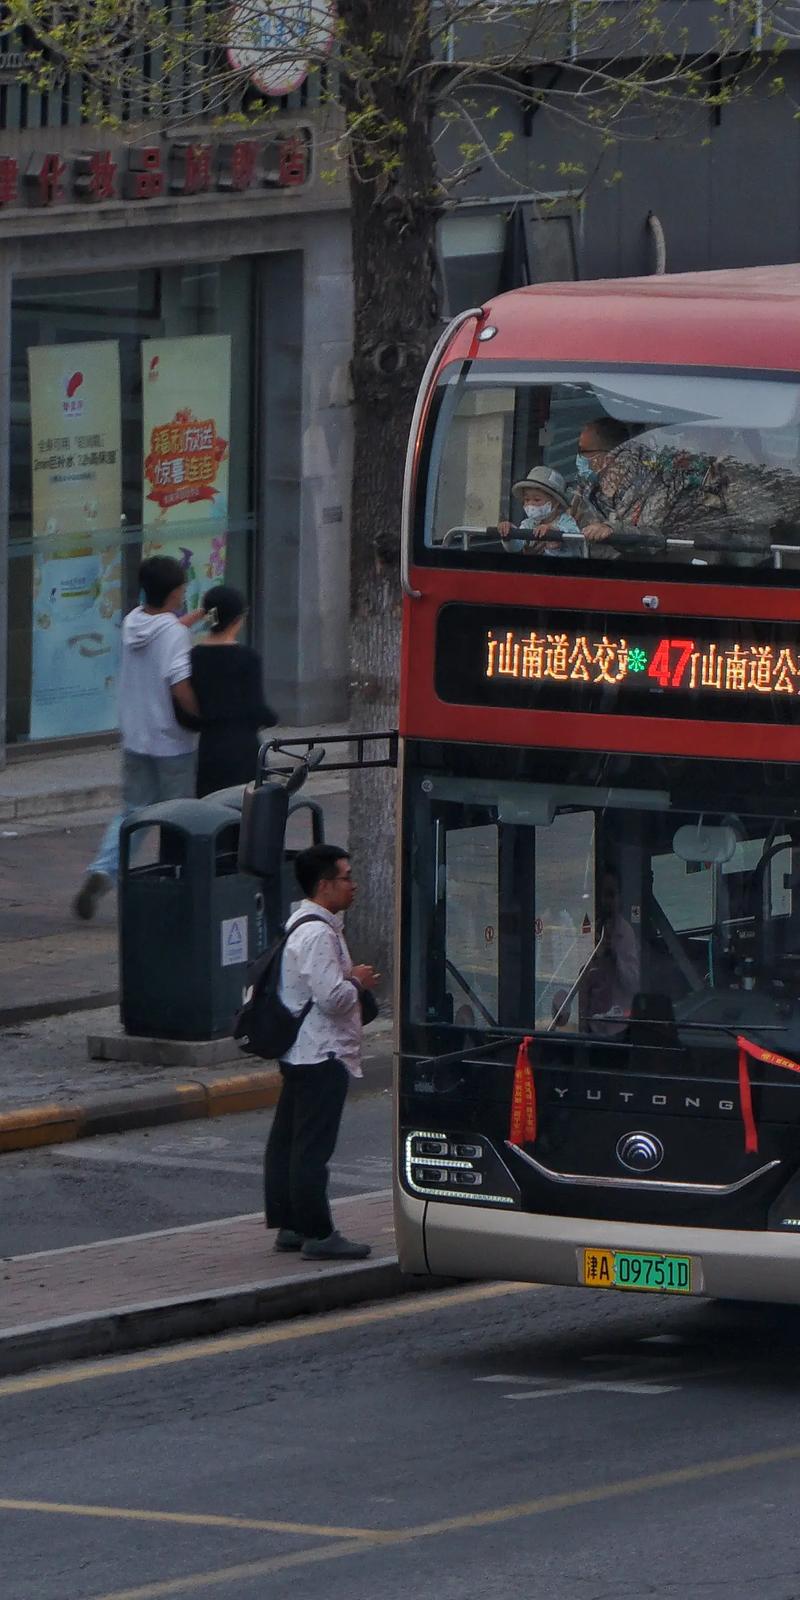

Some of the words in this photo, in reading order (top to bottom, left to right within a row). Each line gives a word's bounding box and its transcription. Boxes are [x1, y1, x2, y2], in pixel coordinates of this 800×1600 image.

[155, 425, 213, 455] 福利放送
[154, 456, 213, 485] 惊喜连连
[647, 639, 694, 687] 47
[689, 644, 800, 695] 山南道公
[555, 1088, 735, 1111] YUTONG
[618, 1257, 689, 1287] 09751D
